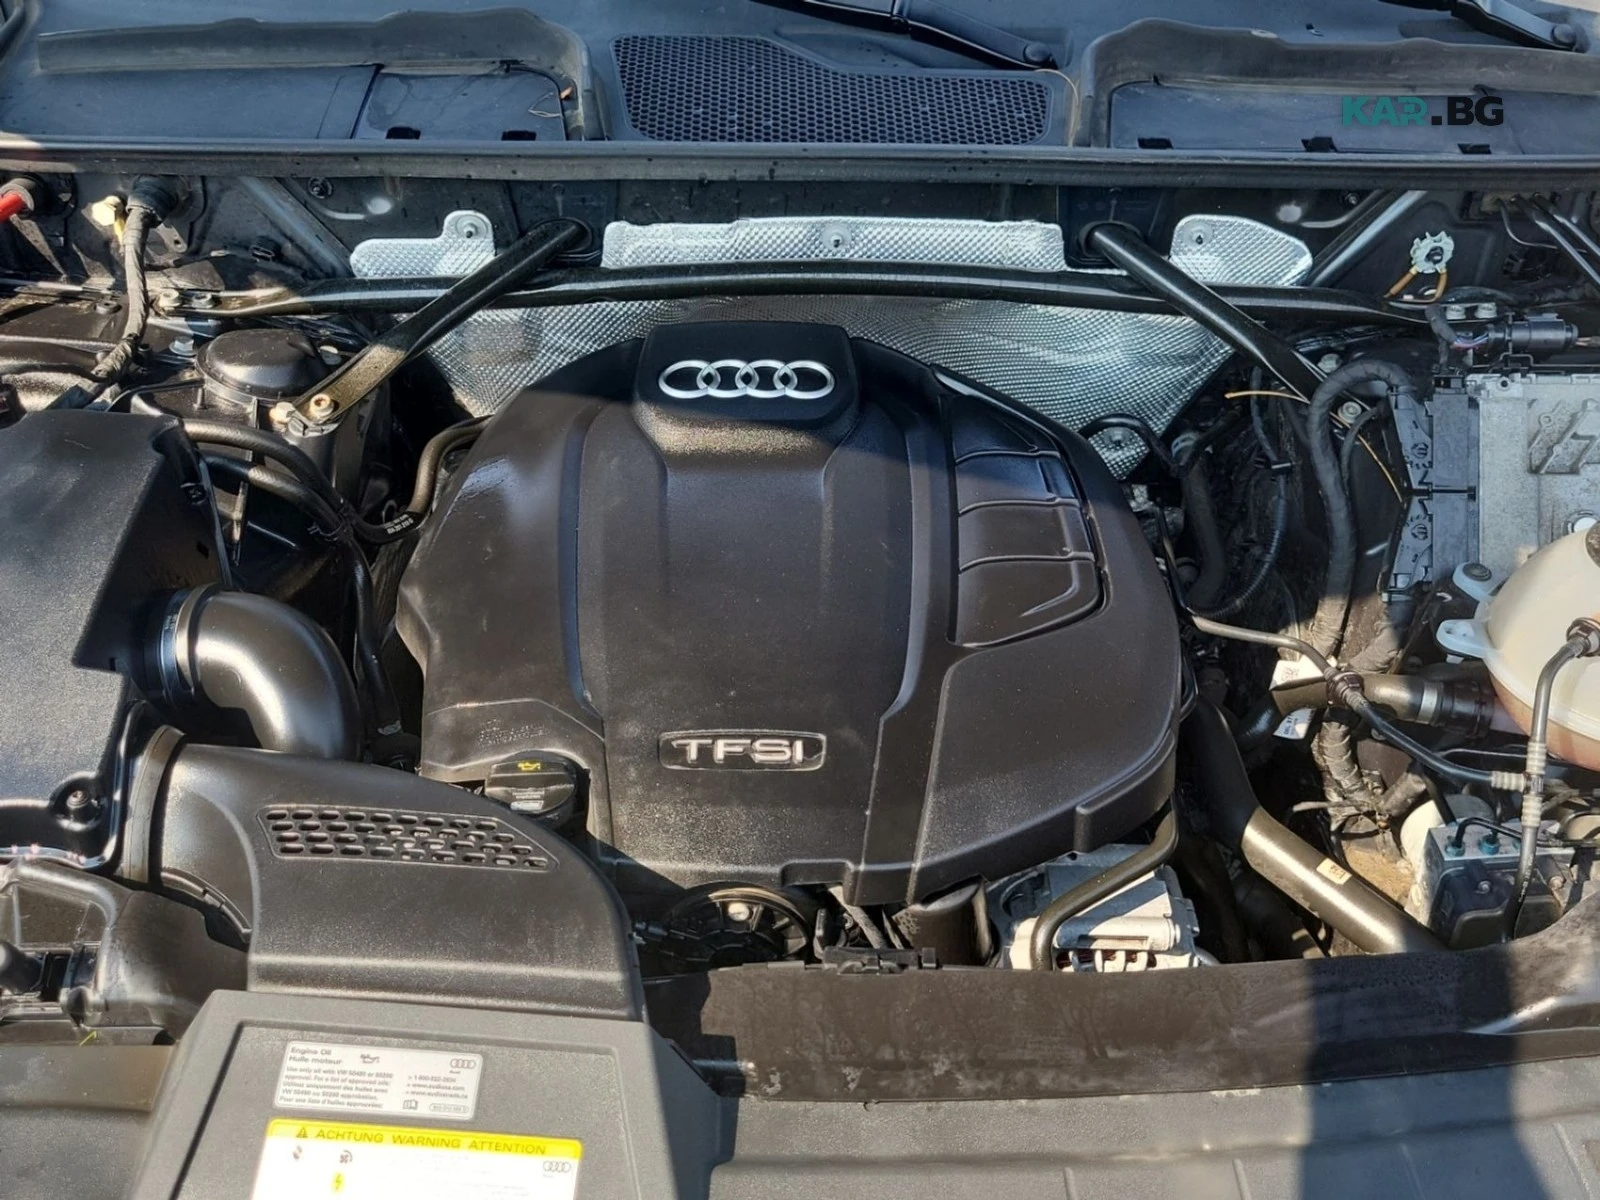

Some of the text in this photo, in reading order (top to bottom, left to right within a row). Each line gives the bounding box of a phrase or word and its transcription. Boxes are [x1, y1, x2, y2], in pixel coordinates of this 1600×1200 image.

[671, 739, 804, 764] TFSI
[291, 1046, 332, 1056] Engine Oil
[288, 1055, 343, 1065] Huile moteur
[315, 1127, 547, 1156] ACHTUNG WARNING ATTENTION
